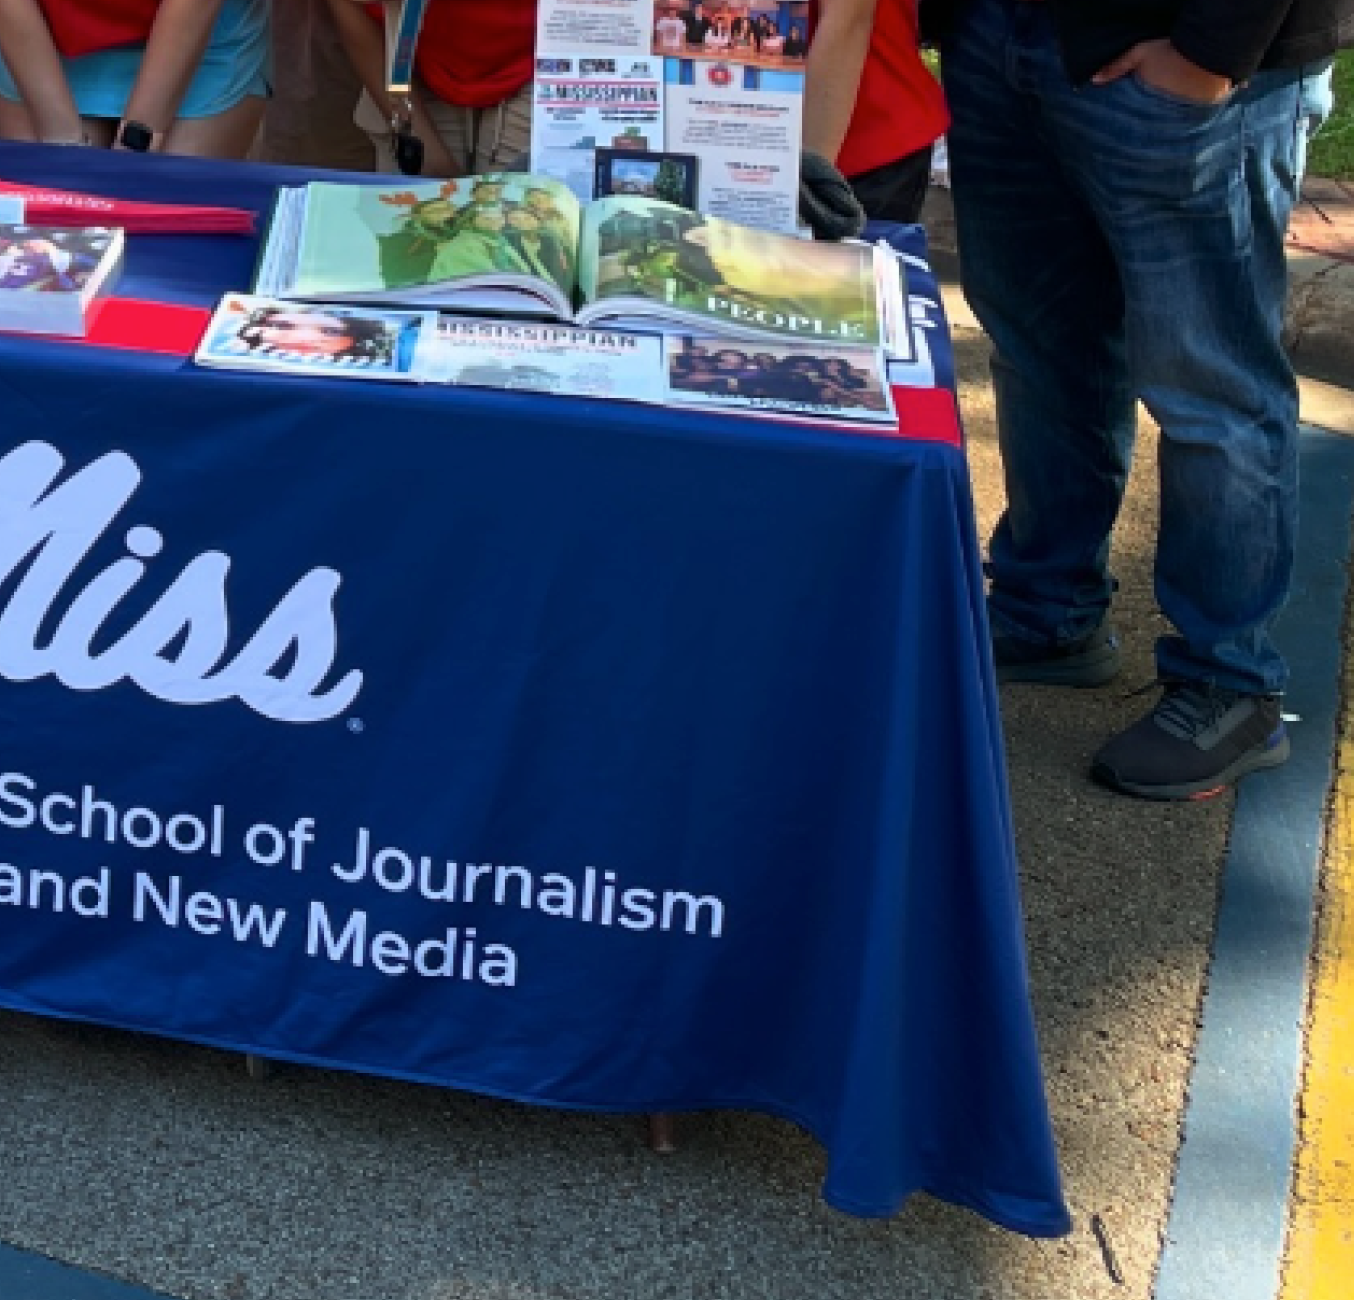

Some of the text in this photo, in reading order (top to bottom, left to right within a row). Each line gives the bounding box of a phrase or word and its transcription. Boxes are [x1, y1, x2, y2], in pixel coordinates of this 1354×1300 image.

[706, 295, 867, 340] PEOPLE
[133, 871, 288, 949] New
[306, 901, 519, 988] Media
[245, 818, 316, 871] of
[331, 827, 725, 939] Journalism
